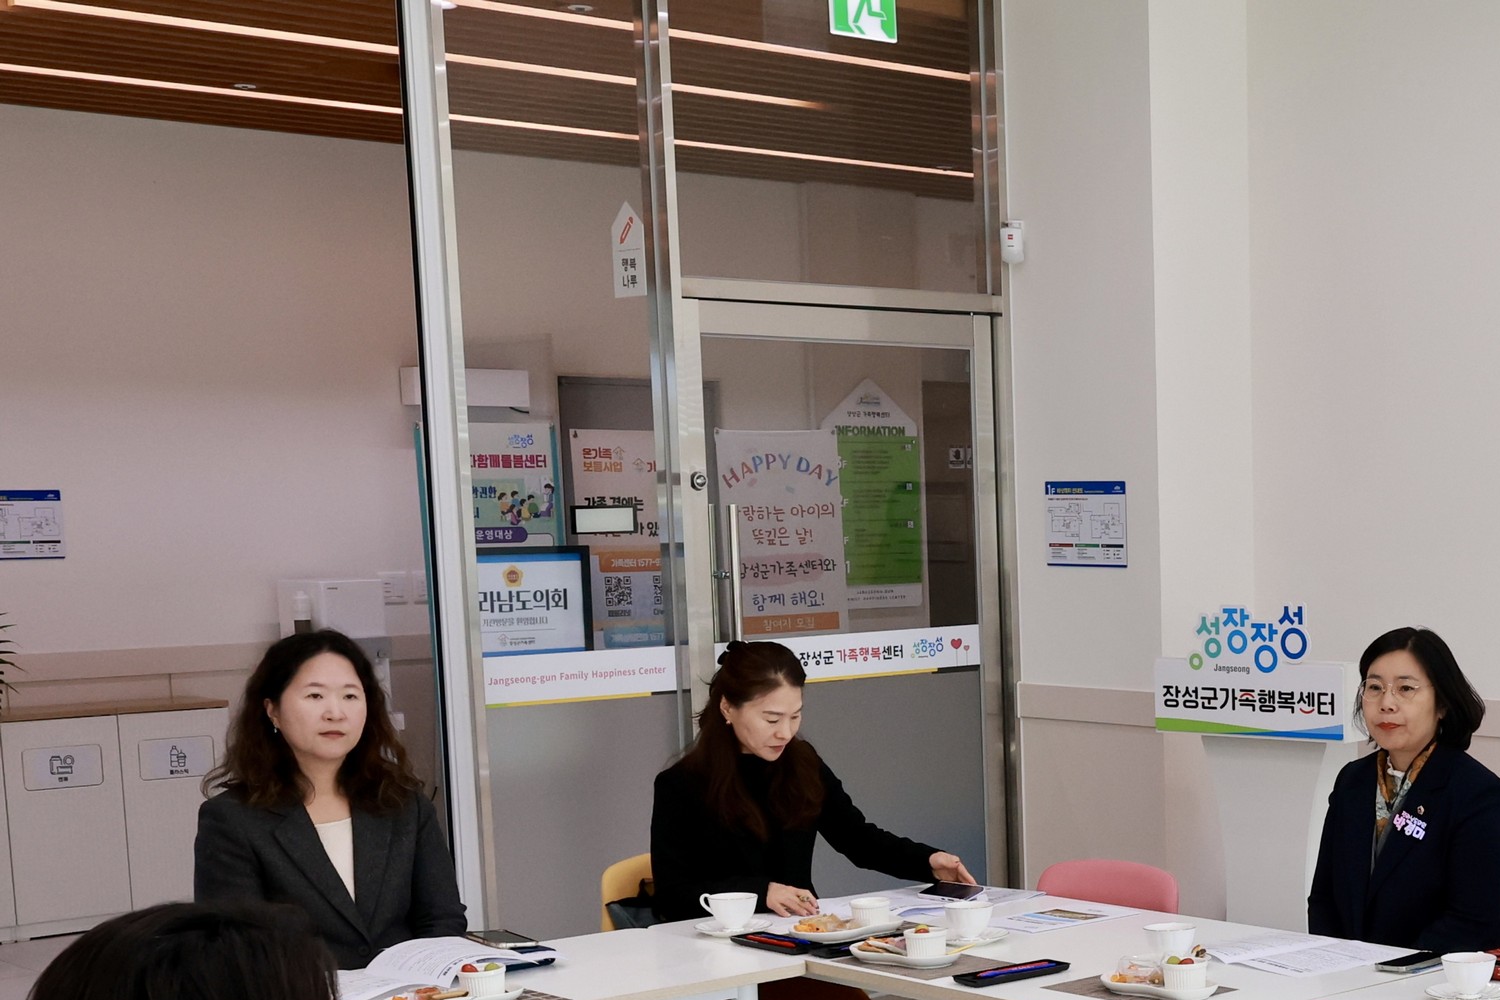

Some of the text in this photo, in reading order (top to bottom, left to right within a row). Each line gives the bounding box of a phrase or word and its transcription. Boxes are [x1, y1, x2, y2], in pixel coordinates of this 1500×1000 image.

[582, 447, 612, 459] 온가족
[722, 453, 791, 488] HAPPY
[796, 456, 838, 486] DAY
[738, 505, 785, 522] 랑하는
[791, 502, 835, 519] 아이의
[476, 529, 513, 540] 운영대상
[752, 527, 813, 546] 뜻깊은 날!
[752, 590, 825, 611] 함께 해요!
[488, 666, 667, 687] Jangseong-gun Family Happiness Center
[1214, 664, 1250, 674] Jangseong
[1162, 685, 1335, 716] 장성군가족행복센터
